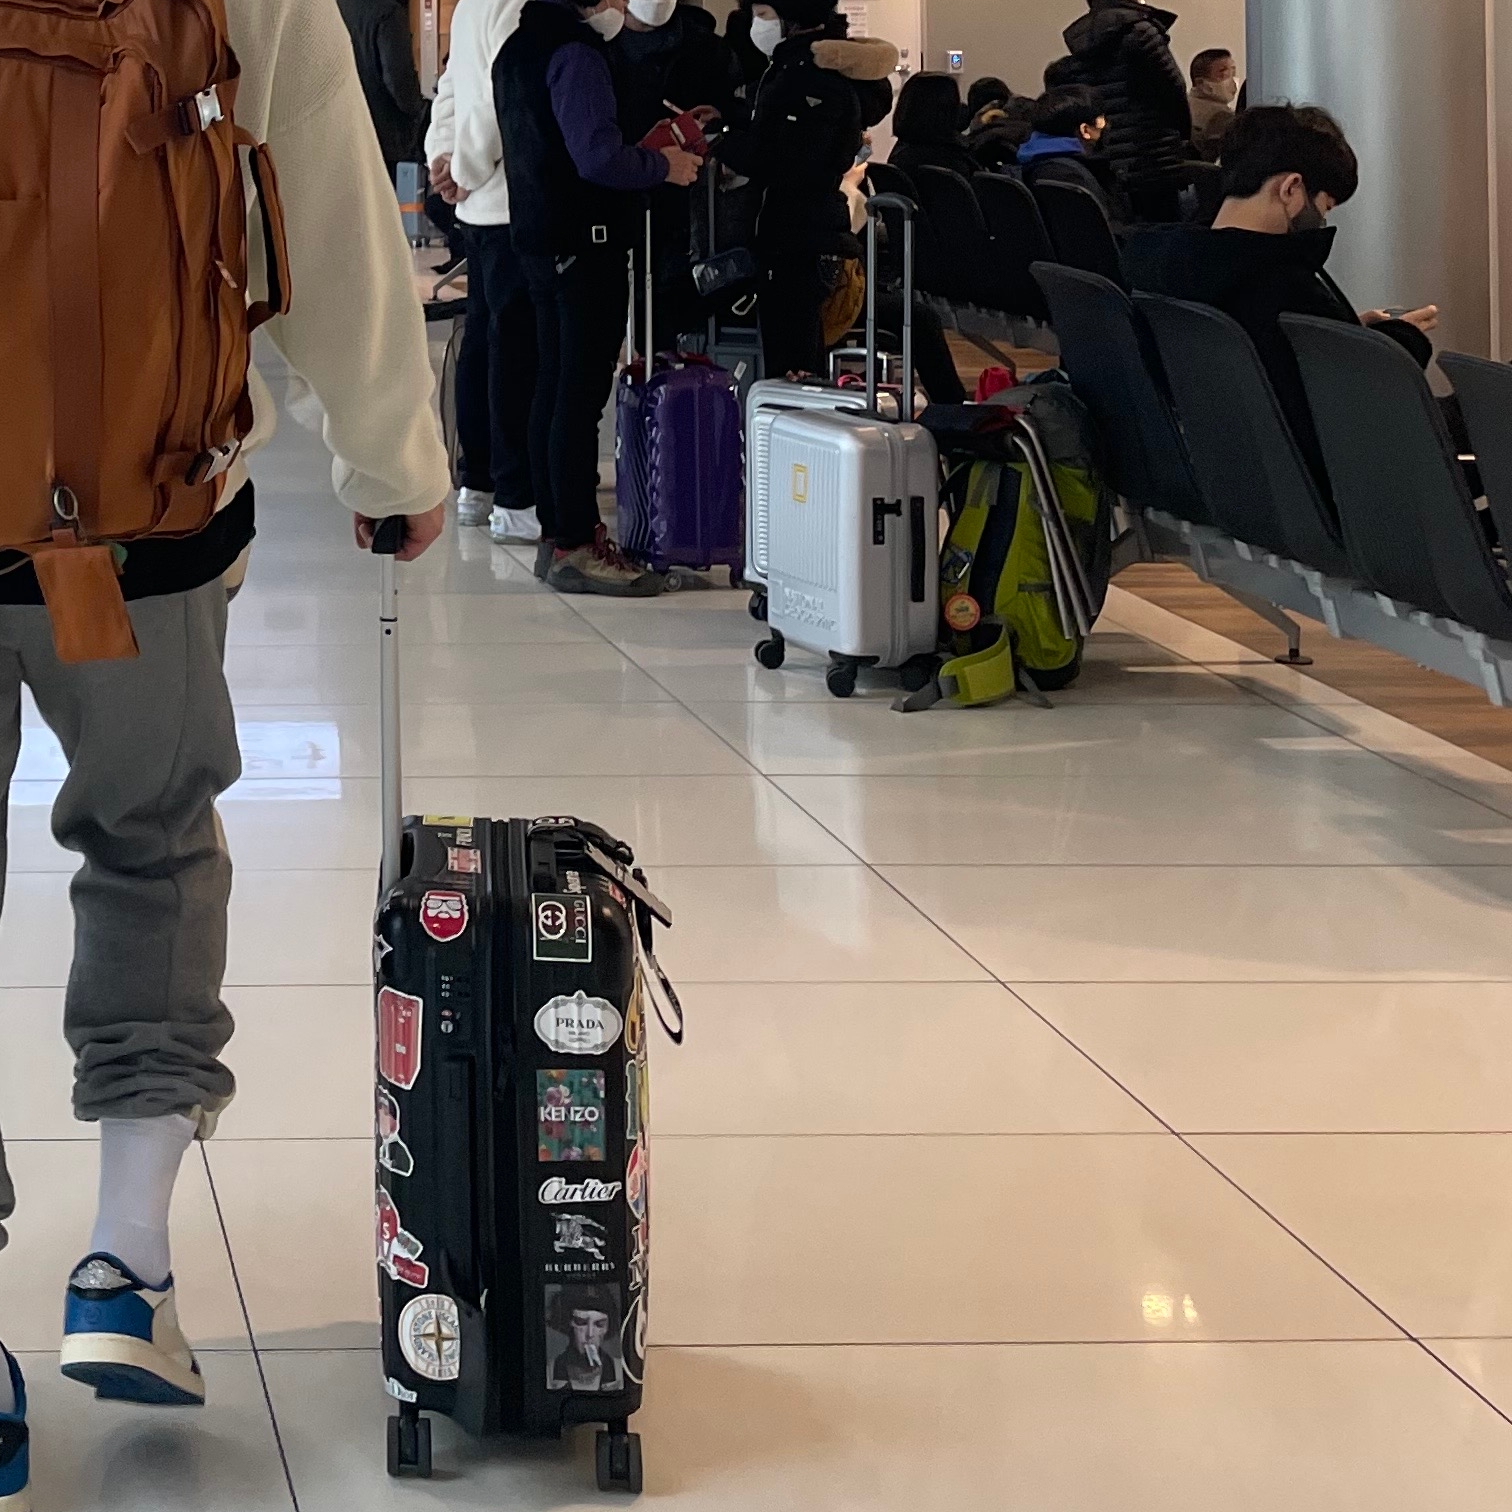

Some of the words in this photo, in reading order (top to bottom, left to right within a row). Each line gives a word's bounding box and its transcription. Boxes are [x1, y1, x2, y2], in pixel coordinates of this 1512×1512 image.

[573, 899, 587, 944] GUCCI
[555, 1017, 605, 1030] PRADA
[539, 1106, 600, 1122] KENZO
[540, 1178, 621, 1202] Cartier
